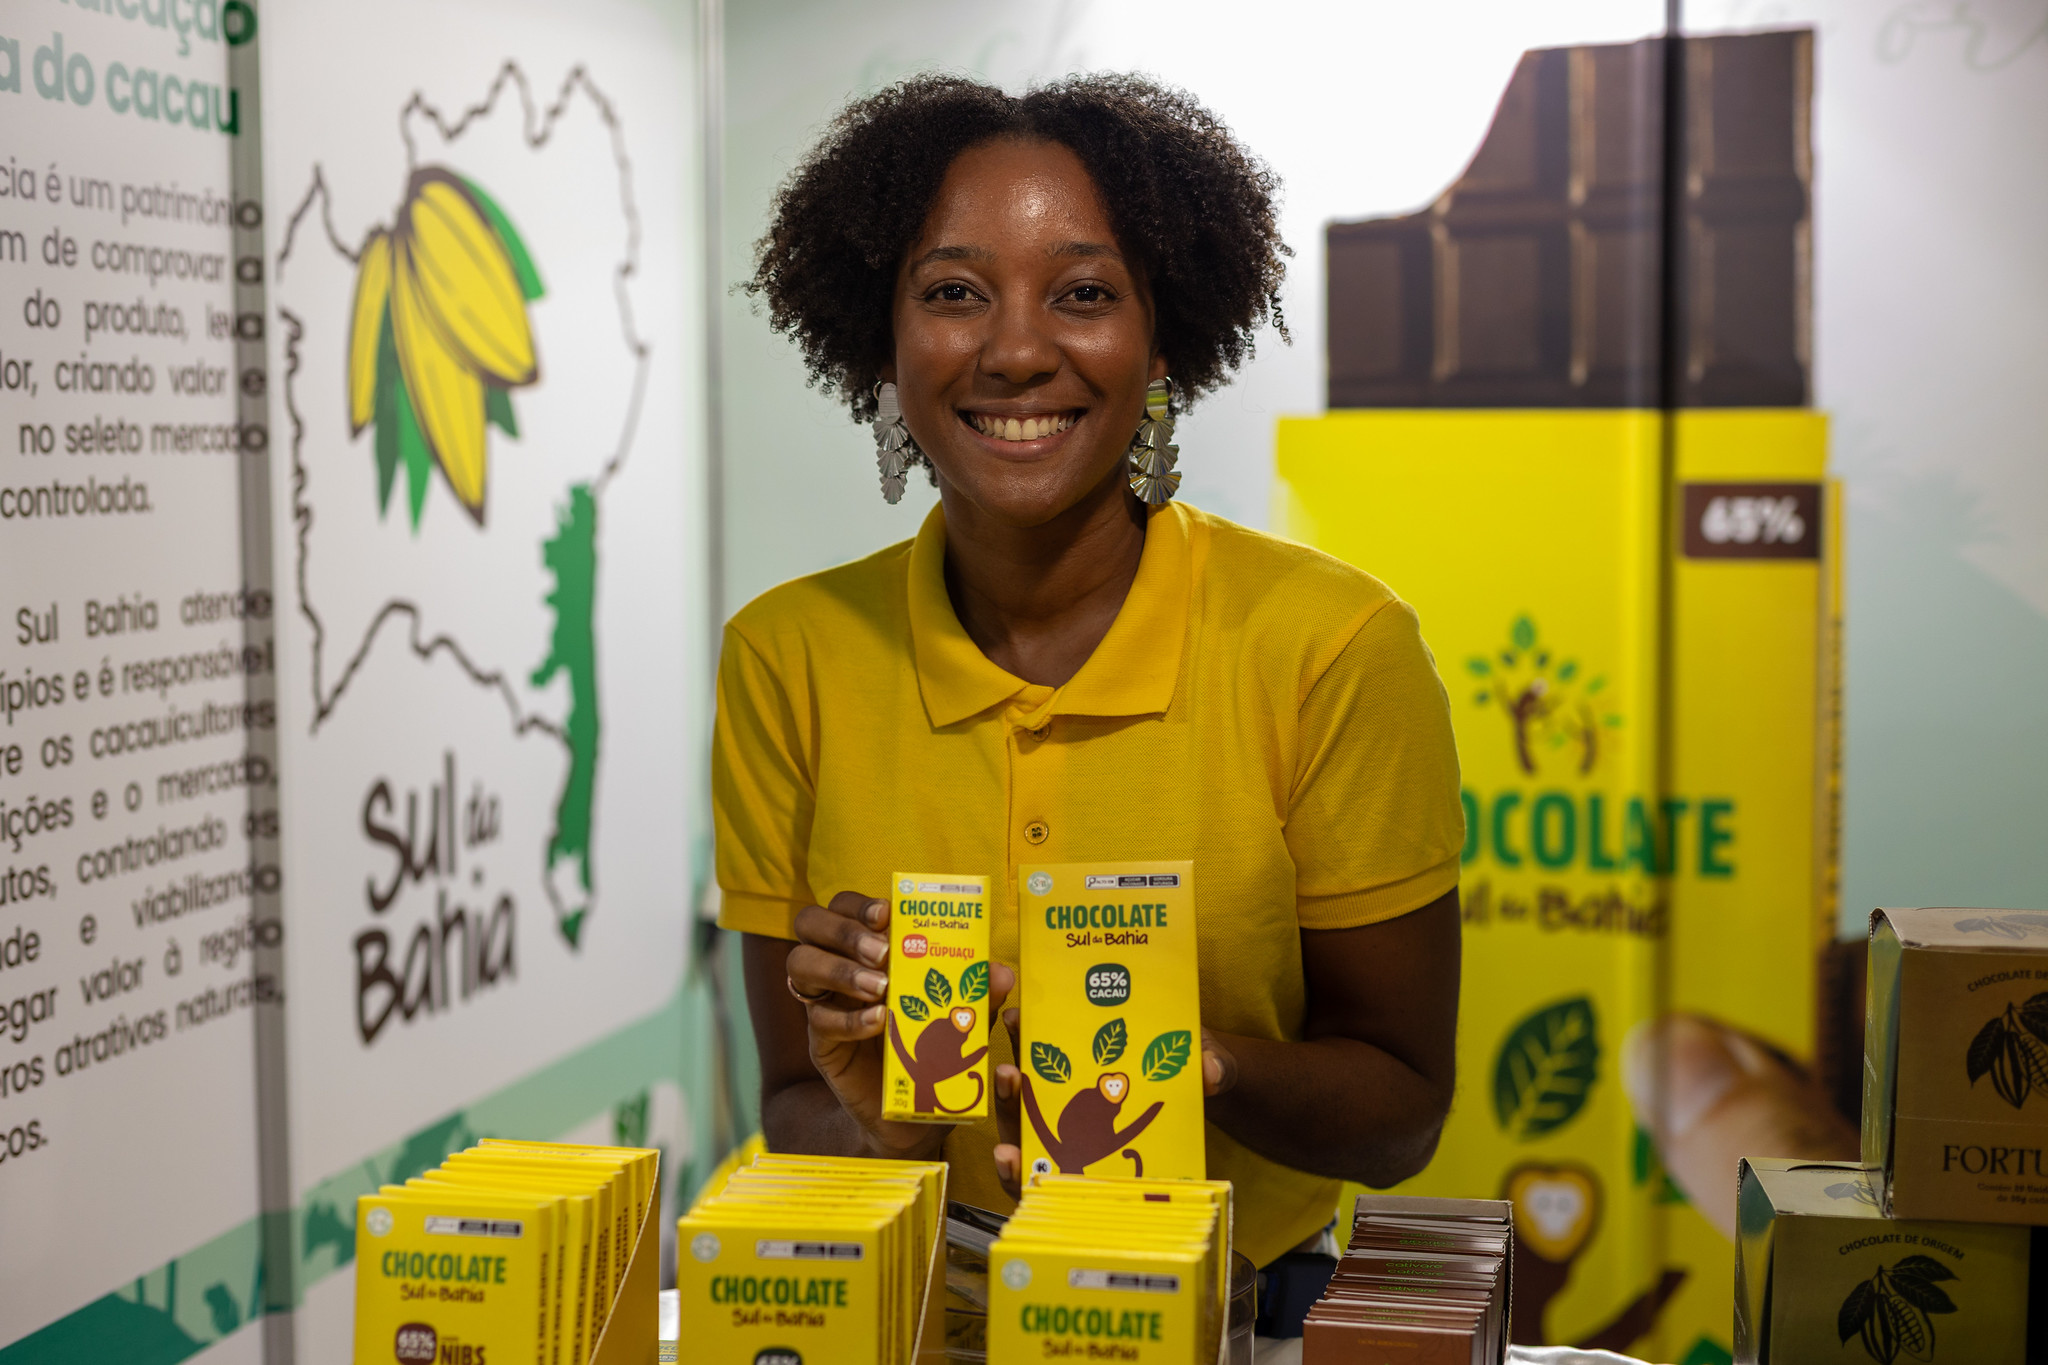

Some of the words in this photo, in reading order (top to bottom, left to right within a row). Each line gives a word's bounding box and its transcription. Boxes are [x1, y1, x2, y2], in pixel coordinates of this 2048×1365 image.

[33, 31, 95, 106] do
[105, 62, 240, 136] cacau
[45, 162, 61, 202] é
[70, 176, 114, 210] um
[42, 227, 77, 267] de
[91, 240, 227, 289] comprovar
[24, 288, 61, 330] do
[84, 296, 189, 345] produto,
[55, 352, 155, 394] criando
[168, 358, 228, 396] valor
[19, 423, 55, 455] no
[64, 415, 143, 455] seleto
[0, 474, 153, 520] controlada.
[1701, 494, 1806, 543] 65%
[16, 602, 59, 646] Sul
[85, 591, 158, 637] Bahia
[73, 669, 90, 702] e
[98, 654, 115, 698] é
[41, 735, 74, 769] os
[91, 789, 108, 821] e
[124, 781, 142, 813] o
[363, 745, 457, 917] Sul
[77, 812, 228, 885] controlando
[900, 900, 983, 919] CHOCOLATE
[913, 918, 930, 929] Sul
[940, 920, 969, 930] Bahia
[1045, 904, 1168, 930] CHOCOLATE
[79, 913, 97, 946] e
[903, 938, 927, 949] 65%
[1066, 931, 1090, 948] Sul
[1092, 935, 1103, 945] da
[1104, 929, 1148, 946] Bahia
[79, 955, 145, 1007] valor
[163, 934, 182, 977] à
[354, 866, 518, 1048] Bahia
[929, 946, 975, 961] CUPUAÇU
[1089, 971, 1128, 988] 65%
[1089, 988, 1127, 999] CACAU
[1967, 970, 2032, 992] CHOCOLATE
[54, 1010, 168, 1078] atrativos
[1839, 1234, 1902, 1257] CHOCOLATE
[1904, 1235, 1919, 1245] DE
[1921, 1237, 1966, 1261] ORIGEM
[381, 1251, 507, 1284] CHOCOLATE
[1385, 1262, 1443, 1270] cativare
[400, 1284, 425, 1301] Sul
[439, 1284, 485, 1302] Bahia
[711, 1275, 848, 1308] CHOCOLATE
[1379, 1285, 1438, 1294] cativare
[1020, 1305, 1162, 1341] CHOCOLATE
[440, 1345, 487, 1365] NIBS
